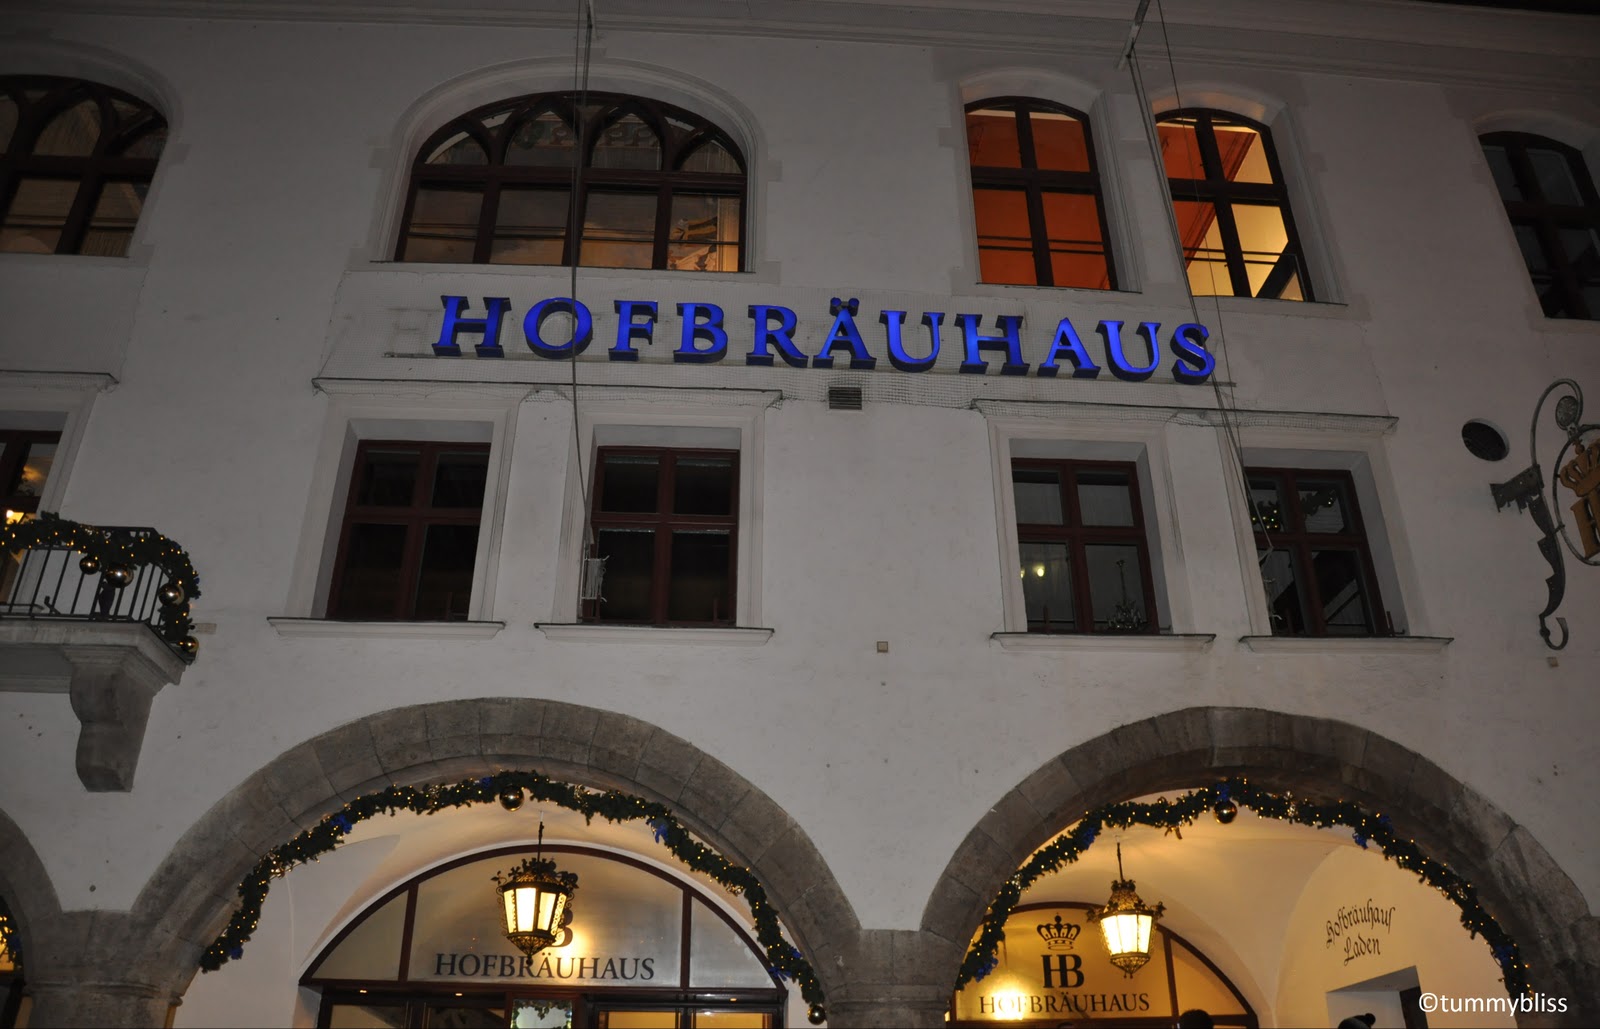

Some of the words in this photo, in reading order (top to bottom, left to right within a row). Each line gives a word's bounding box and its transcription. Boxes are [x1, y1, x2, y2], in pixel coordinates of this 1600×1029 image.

[432, 294, 1216, 383] HOFBRÄUHAUS
[435, 952, 655, 980] HOFBRÄUHAUS
[1344, 933, 1381, 967] Laden
[1042, 953, 1085, 989] HB
